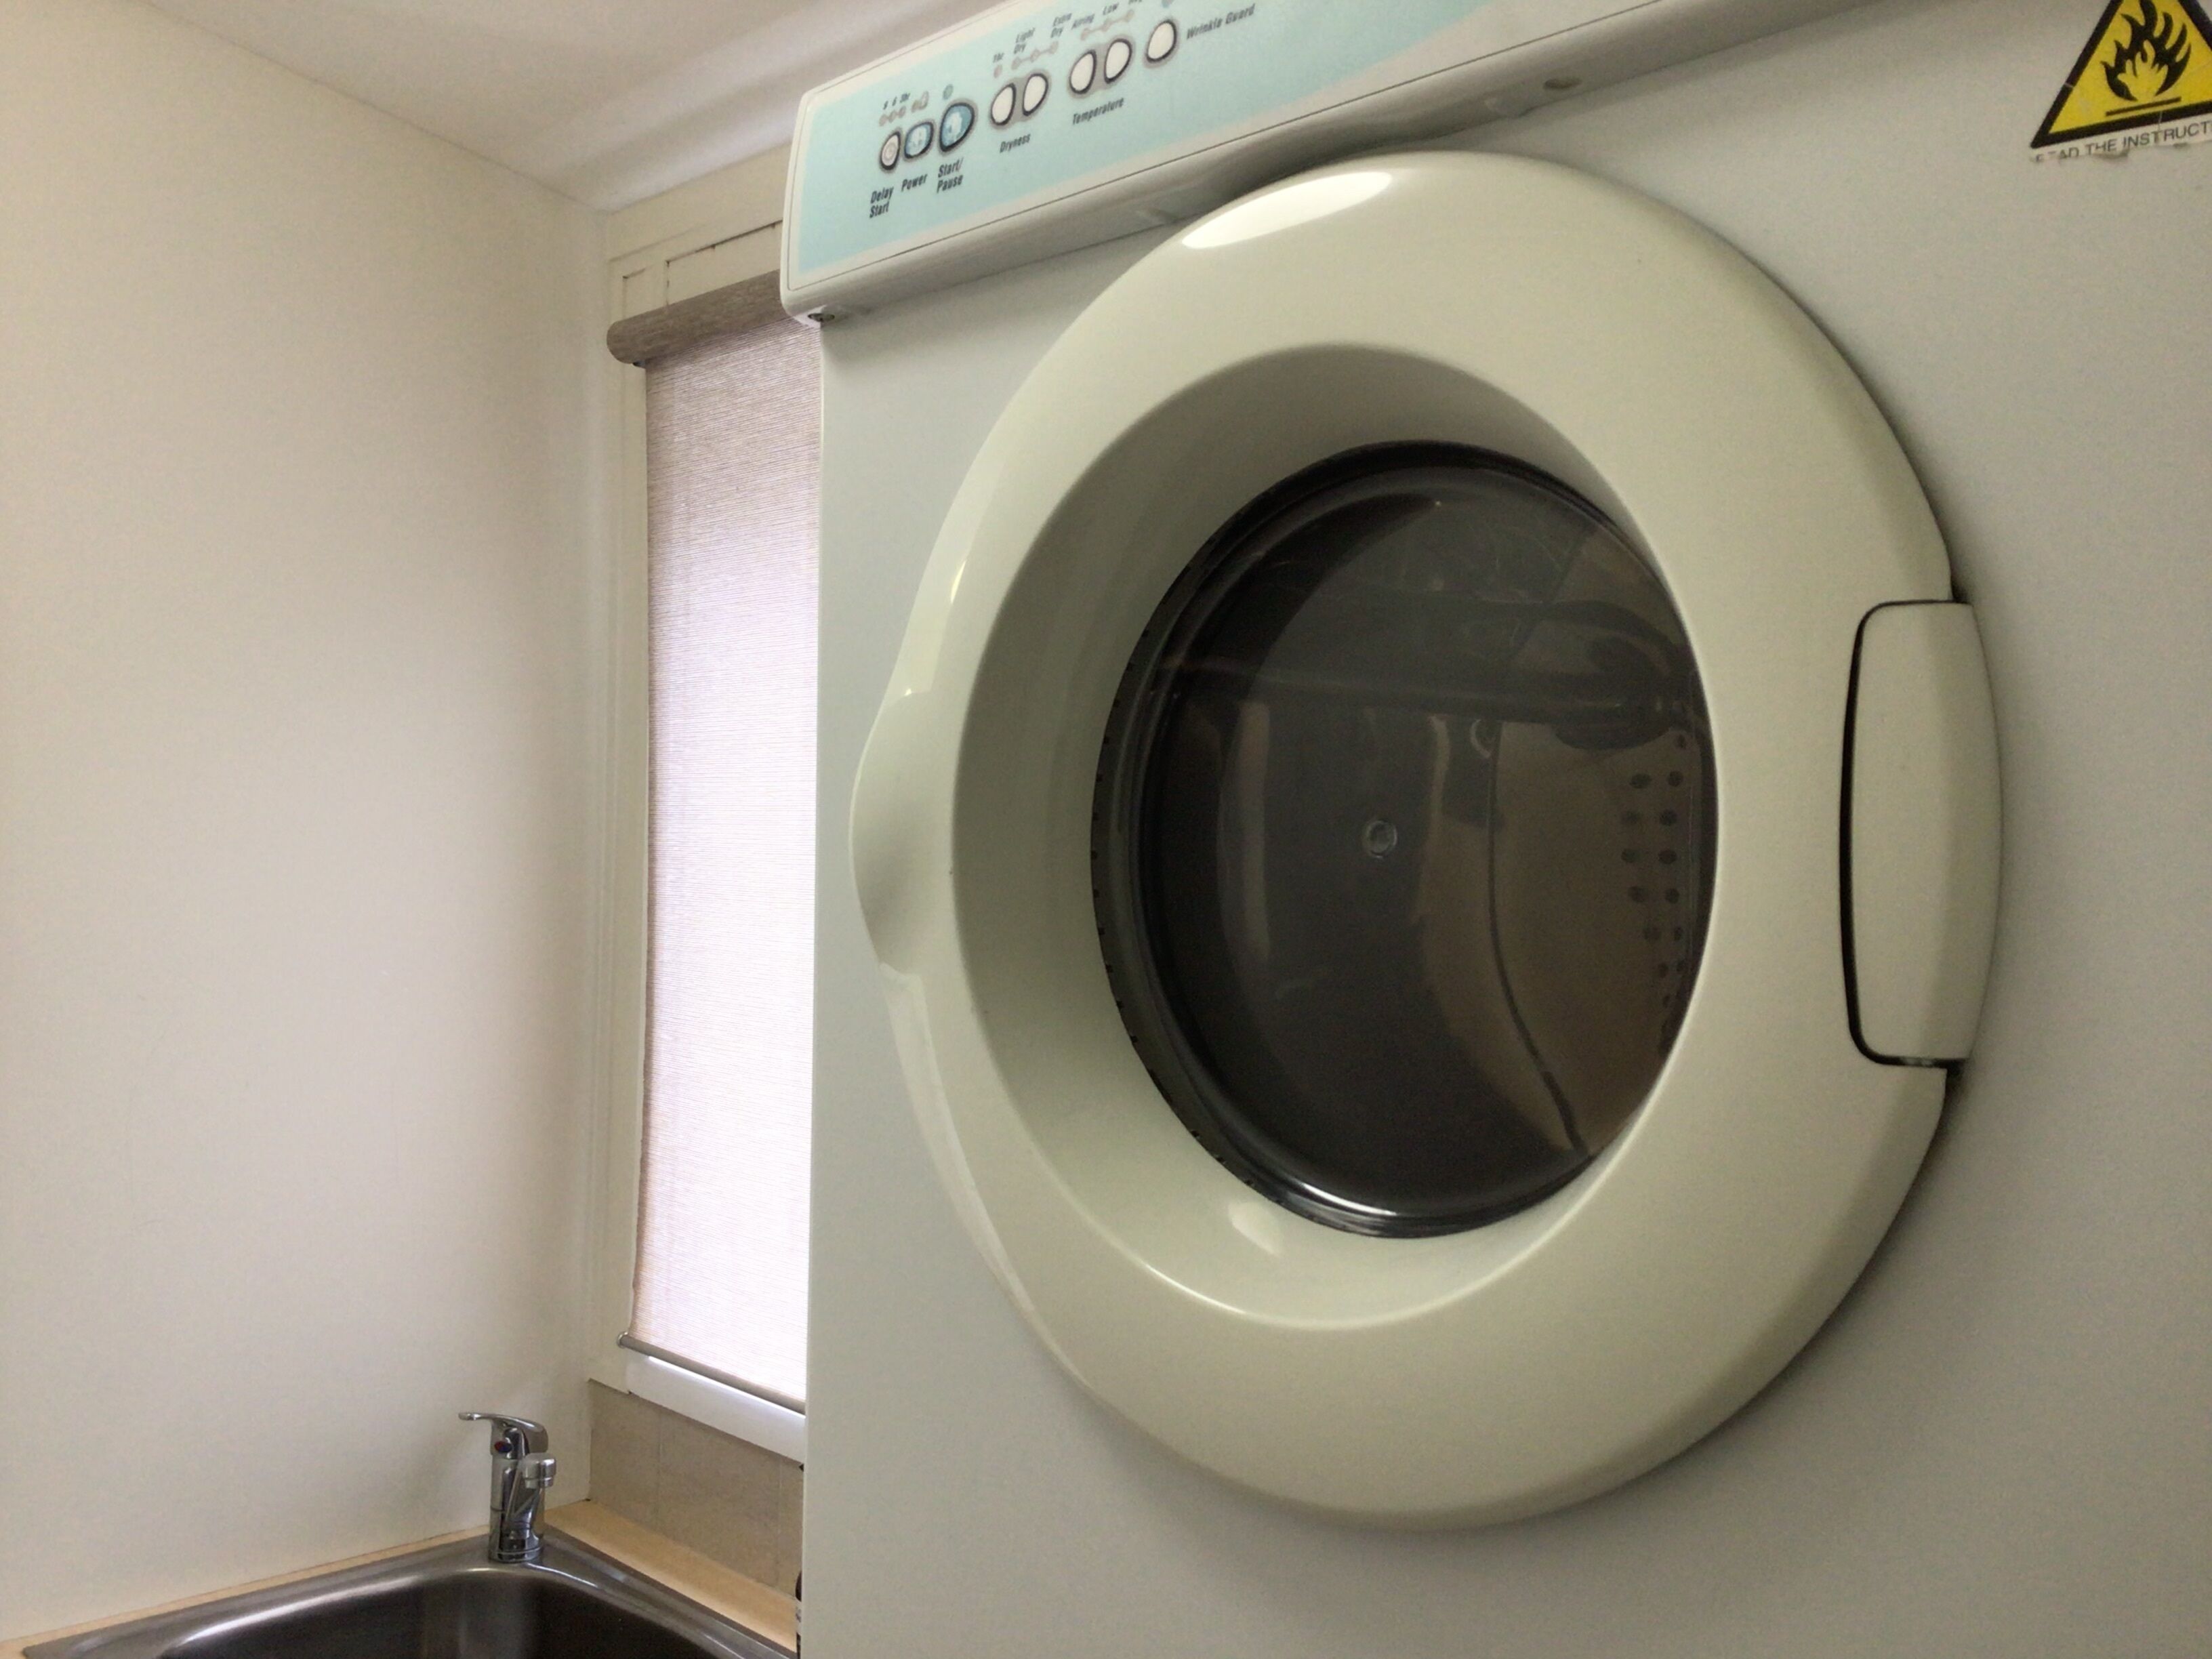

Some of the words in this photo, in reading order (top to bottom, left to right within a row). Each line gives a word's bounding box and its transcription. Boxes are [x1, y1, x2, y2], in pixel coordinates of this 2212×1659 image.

[1186, 18, 1223, 40] Wrinkle
[1225, 4, 1256, 25] Guard
[1016, 27, 1036, 43] Light
[1072, 97, 1125, 125] Temperature
[1000, 134, 1031, 153] Dryness
[2036, 146, 2079, 162] AD
[2085, 138, 2118, 155] THE
[2123, 121, 2212, 148] INSTRUCT
[938, 157, 964, 178] Start/
[901, 173, 928, 192] Power
[937, 173, 964, 193] Pause
[870, 186, 894, 204] Delay
[869, 201, 890, 218] Start
